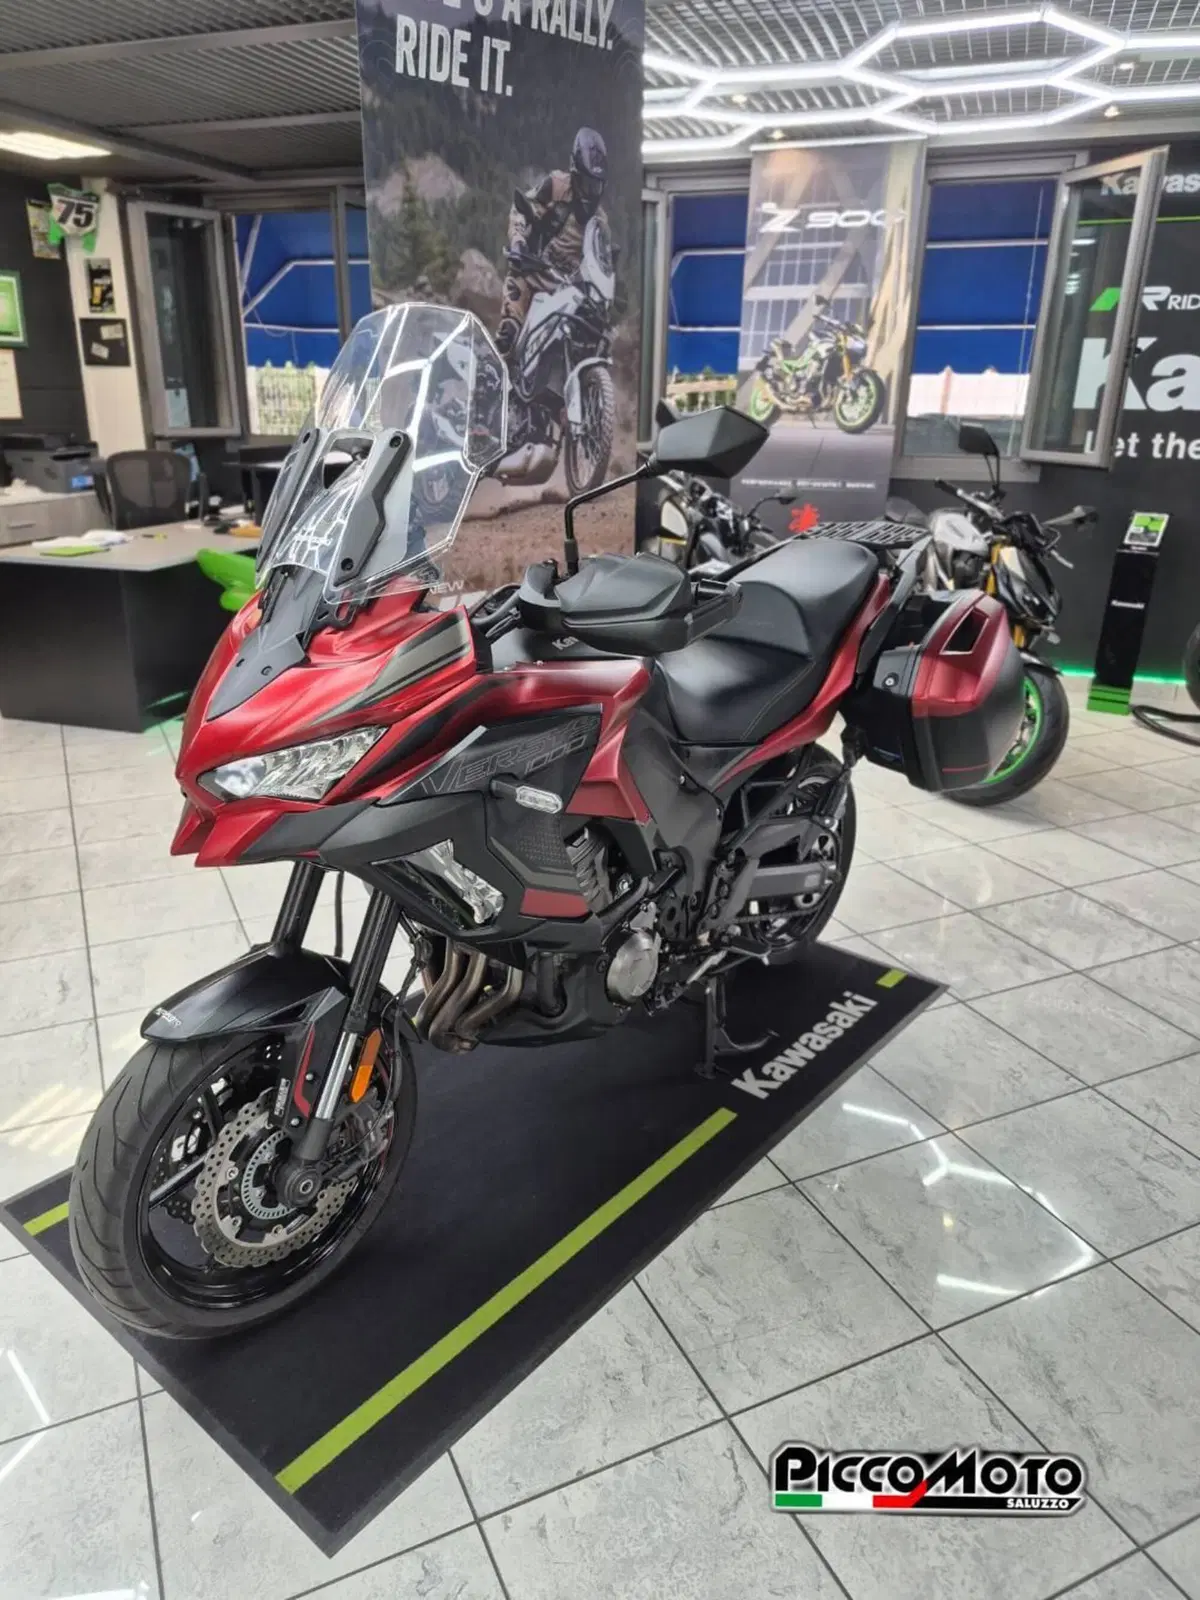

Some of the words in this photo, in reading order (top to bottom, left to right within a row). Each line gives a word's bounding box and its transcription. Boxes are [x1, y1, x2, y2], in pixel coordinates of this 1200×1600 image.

[395, 14, 471, 88] RIDE
[480, 36, 513, 97] IT.
[1100, 173, 1200, 196] Kaas
[57, 199, 94, 228] 75
[1151, 431, 1200, 459] the
[731, 990, 878, 1100] Kawasaki
